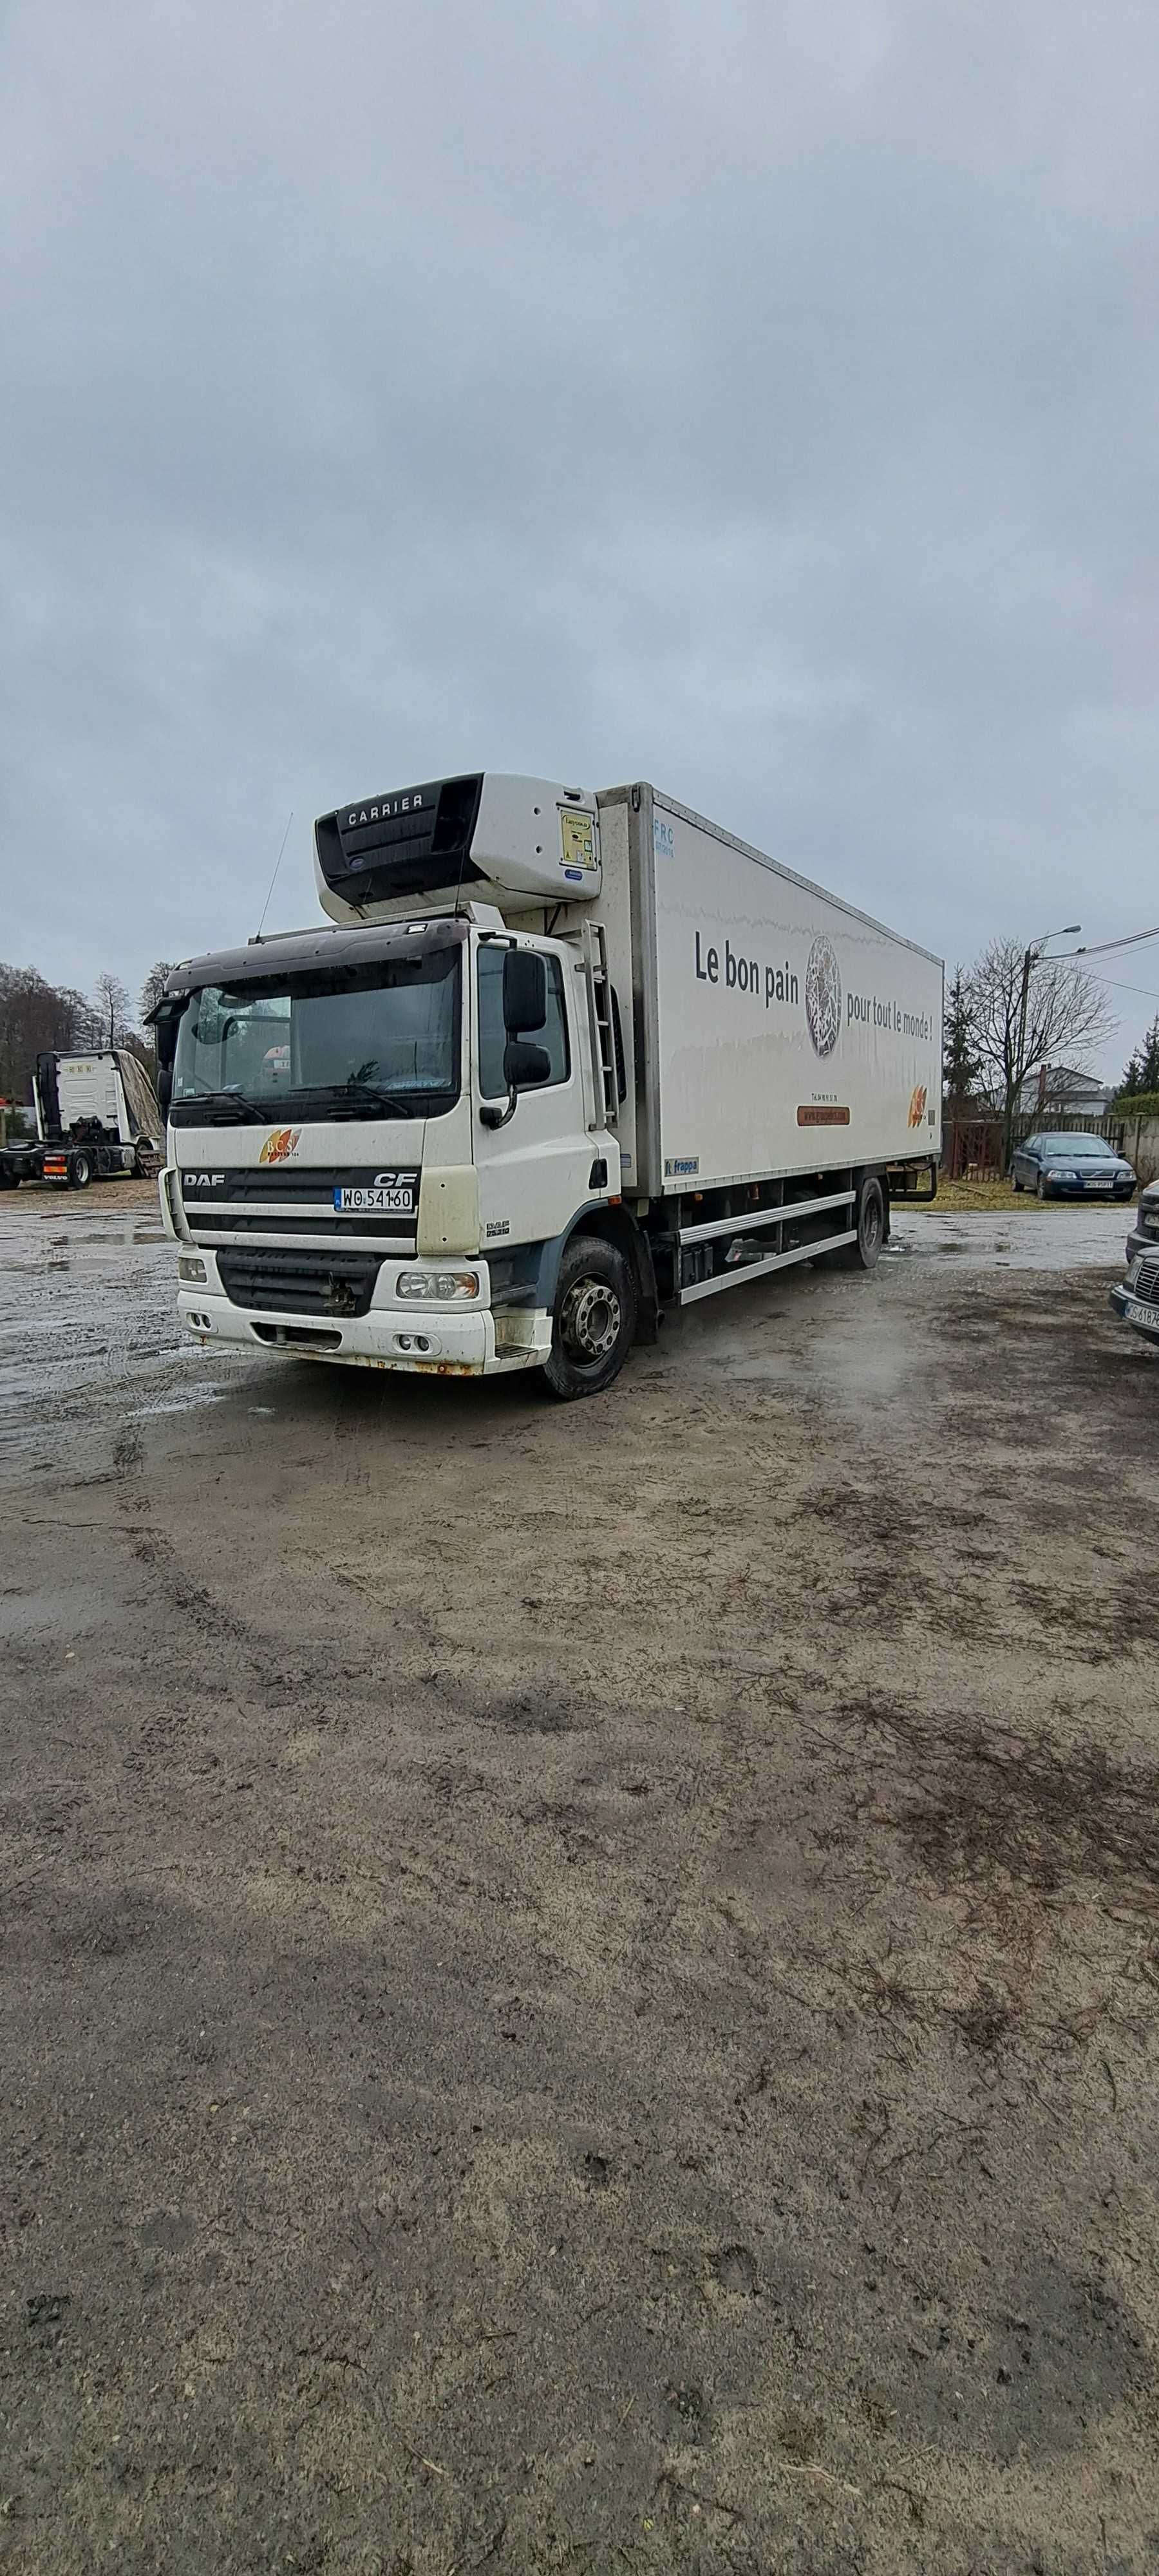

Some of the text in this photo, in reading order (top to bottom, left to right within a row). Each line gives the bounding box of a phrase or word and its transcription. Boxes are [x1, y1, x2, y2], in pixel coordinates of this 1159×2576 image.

[348, 795, 422, 825] CARRIER
[654, 819, 674, 844] FRC
[695, 931, 719, 984] Le
[725, 939, 759, 994] bon
[765, 960, 798, 1009] pain
[847, 992, 871, 1027] pour
[872, 996, 892, 1030] tout
[893, 1000, 902, 1033] le
[903, 1010, 928, 1040] monde
[267, 1139, 292, 1153] BCS
[674, 1160, 697, 1174] frappa
[184, 1173, 225, 1186] DAF
[373, 1173, 418, 1188] CF
[367, 1189, 410, 1207] 54160
[486, 1220, 510, 1230] DAF
